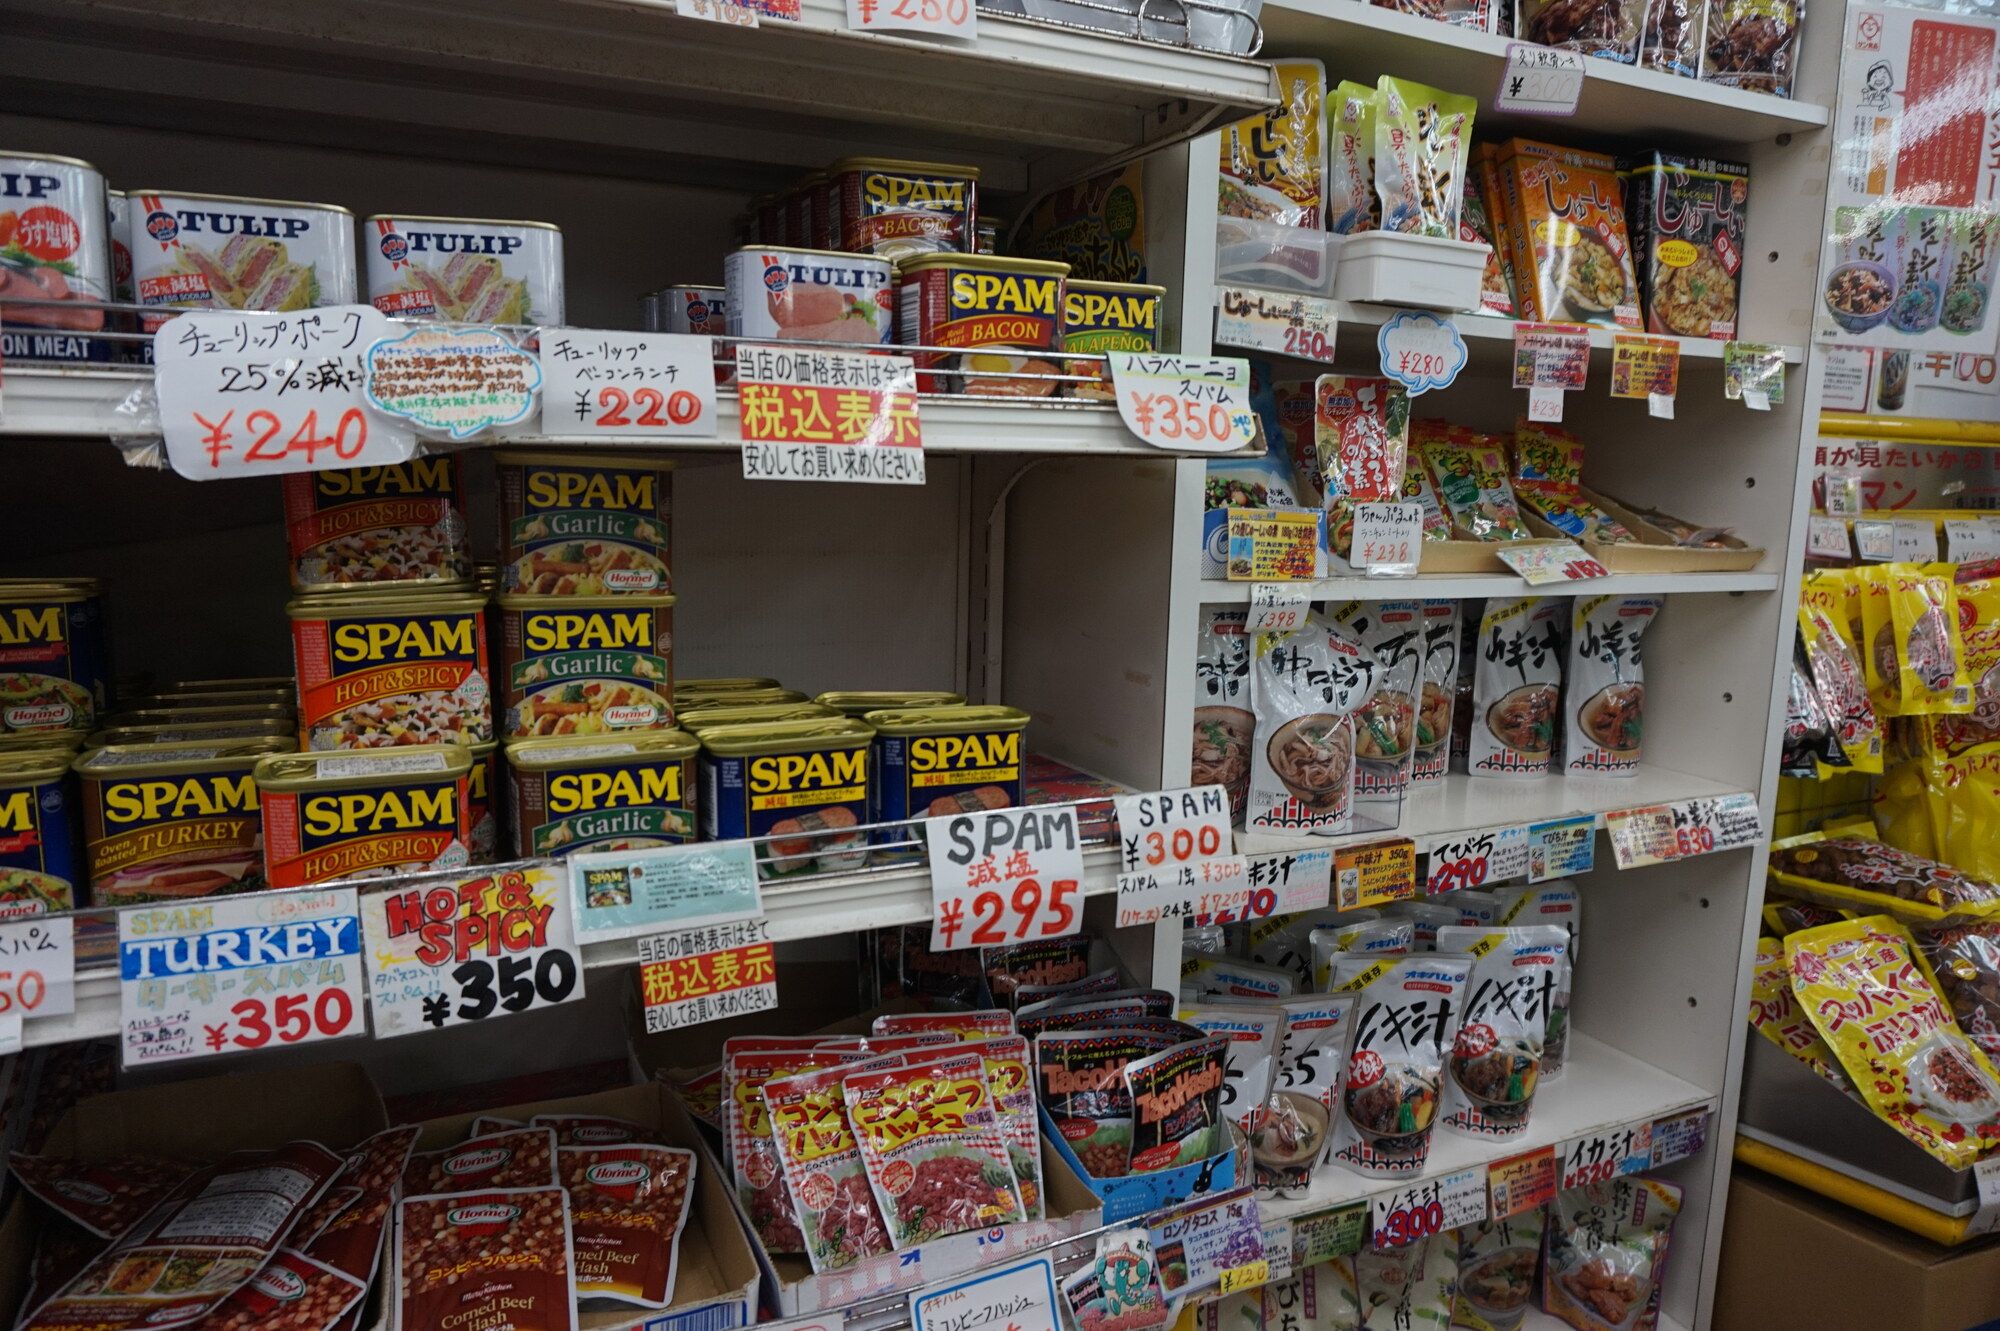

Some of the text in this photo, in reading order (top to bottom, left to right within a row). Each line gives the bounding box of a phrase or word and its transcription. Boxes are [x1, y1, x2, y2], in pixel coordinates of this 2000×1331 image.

[865, 174, 965, 211] SPAM
[20, 221, 78, 250] うす塩味
[177, 210, 311, 239] TULIP
[407, 231, 523, 255] TULIP
[884, 217, 951, 236] BACON
[788, 264, 888, 289] TULIP
[951, 272, 1057, 315] SPAM
[1064, 292, 1156, 330] SPAM
[35, 337, 90, 358] MEAT
[971, 321, 1040, 342] BACON
[554, 340, 647, 361] チューリップ
[1399, 350, 1444, 375] ¥280
[738, 350, 914, 390] 当店の価格表示は全て
[574, 386, 703, 428] ¥220
[743, 385, 920, 443] 税込表示
[1129, 390, 1233, 442] ¥350
[193, 407, 367, 468] ¥240
[745, 445, 925, 482] 安心してお買い求めください。
[526, 470, 656, 510] SPAM
[550, 513, 626, 536] Garlic
[1363, 541, 1409, 563] ¥238
[608, 572, 654, 585] Hormel
[525, 612, 653, 650] SPAM
[1255, 611, 1297, 628] ¥398
[333, 618, 475, 662] SPAM
[550, 653, 624, 676] Garlic
[334, 665, 465, 705] HOT&SPICY
[12, 707, 66, 722] Hormel
[609, 709, 654, 721] Hormel
[911, 732, 1020, 772] SPAM
[548, 765, 681, 814] SPAM
[750, 750, 867, 794] SPAM
[106, 774, 262, 823] SPAM
[304, 786, 457, 838] SPAM
[1139, 793, 1222, 828] SPAM
[138, 822, 247, 852] TURKEY
[574, 811, 652, 837] Garlic
[947, 811, 1076, 866] SPAM
[94, 846, 138, 870] Roasted
[100, 840, 131, 857] Oven
[304, 836, 445, 882] HOT&SPICY
[1124, 824, 1221, 871] ¥300
[1432, 832, 1496, 863] てびち
[589, 871, 623, 884] SPAM
[967, 850, 1039, 889] 減塩
[1426, 856, 1490, 895] ¥290
[130, 905, 215, 936] SPAM
[385, 876, 496, 939] HOT
[939, 878, 1079, 948] ¥295
[125, 917, 352, 980] TURKEY
[414, 904, 553, 968] SPICY
[638, 919, 771, 963] 当店の価格表示は全て
[421, 948, 578, 1029] ¥350
[643, 945, 775, 1006] 税込表示
[1404, 971, 1452, 982] オキハム
[203, 987, 353, 1052] ¥350
[646, 987, 779, 1034] 安心してお買い求めください。
[1193, 1021, 1252, 1036] オキハム
[860, 1079, 983, 1125] コンビーフ
[1134, 1060, 1223, 1126] TacoHash
[873, 1113, 965, 1151] ハッシュ
[1567, 1129, 1636, 1167] イカ汁
[453, 1153, 502, 1173] Hormel
[594, 1166, 642, 1181] Hormel
[458, 1206, 512, 1222] Hormel
[1163, 1209, 1219, 1240] ロングタコス
[1374, 1200, 1445, 1249] ¥300
[604, 1250, 640, 1264] Beef
[1222, 1266, 1267, 1294] ¥120
[441, 1299, 497, 1330] Corned
[467, 1310, 508, 1331] Hash
[499, 1295, 536, 1311] Beef
